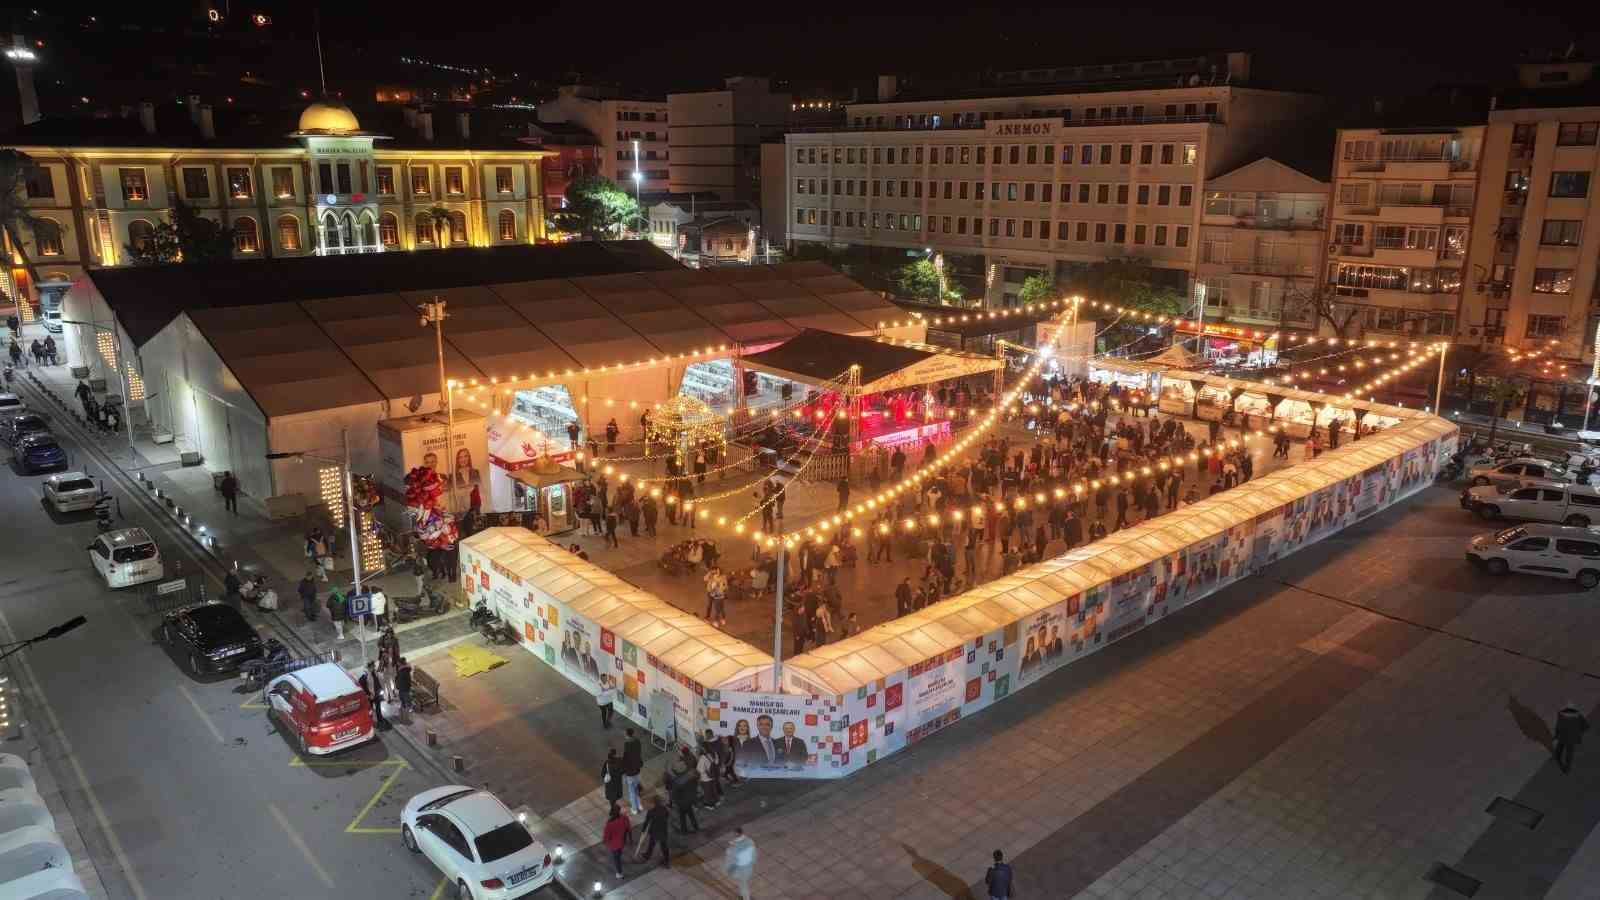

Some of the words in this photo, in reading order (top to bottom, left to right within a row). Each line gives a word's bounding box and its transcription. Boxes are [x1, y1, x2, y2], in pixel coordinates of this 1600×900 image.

[996, 123, 1051, 135] ANEMON
[355, 599, 365, 611] D
[733, 706, 763, 714] RAMAZAN
